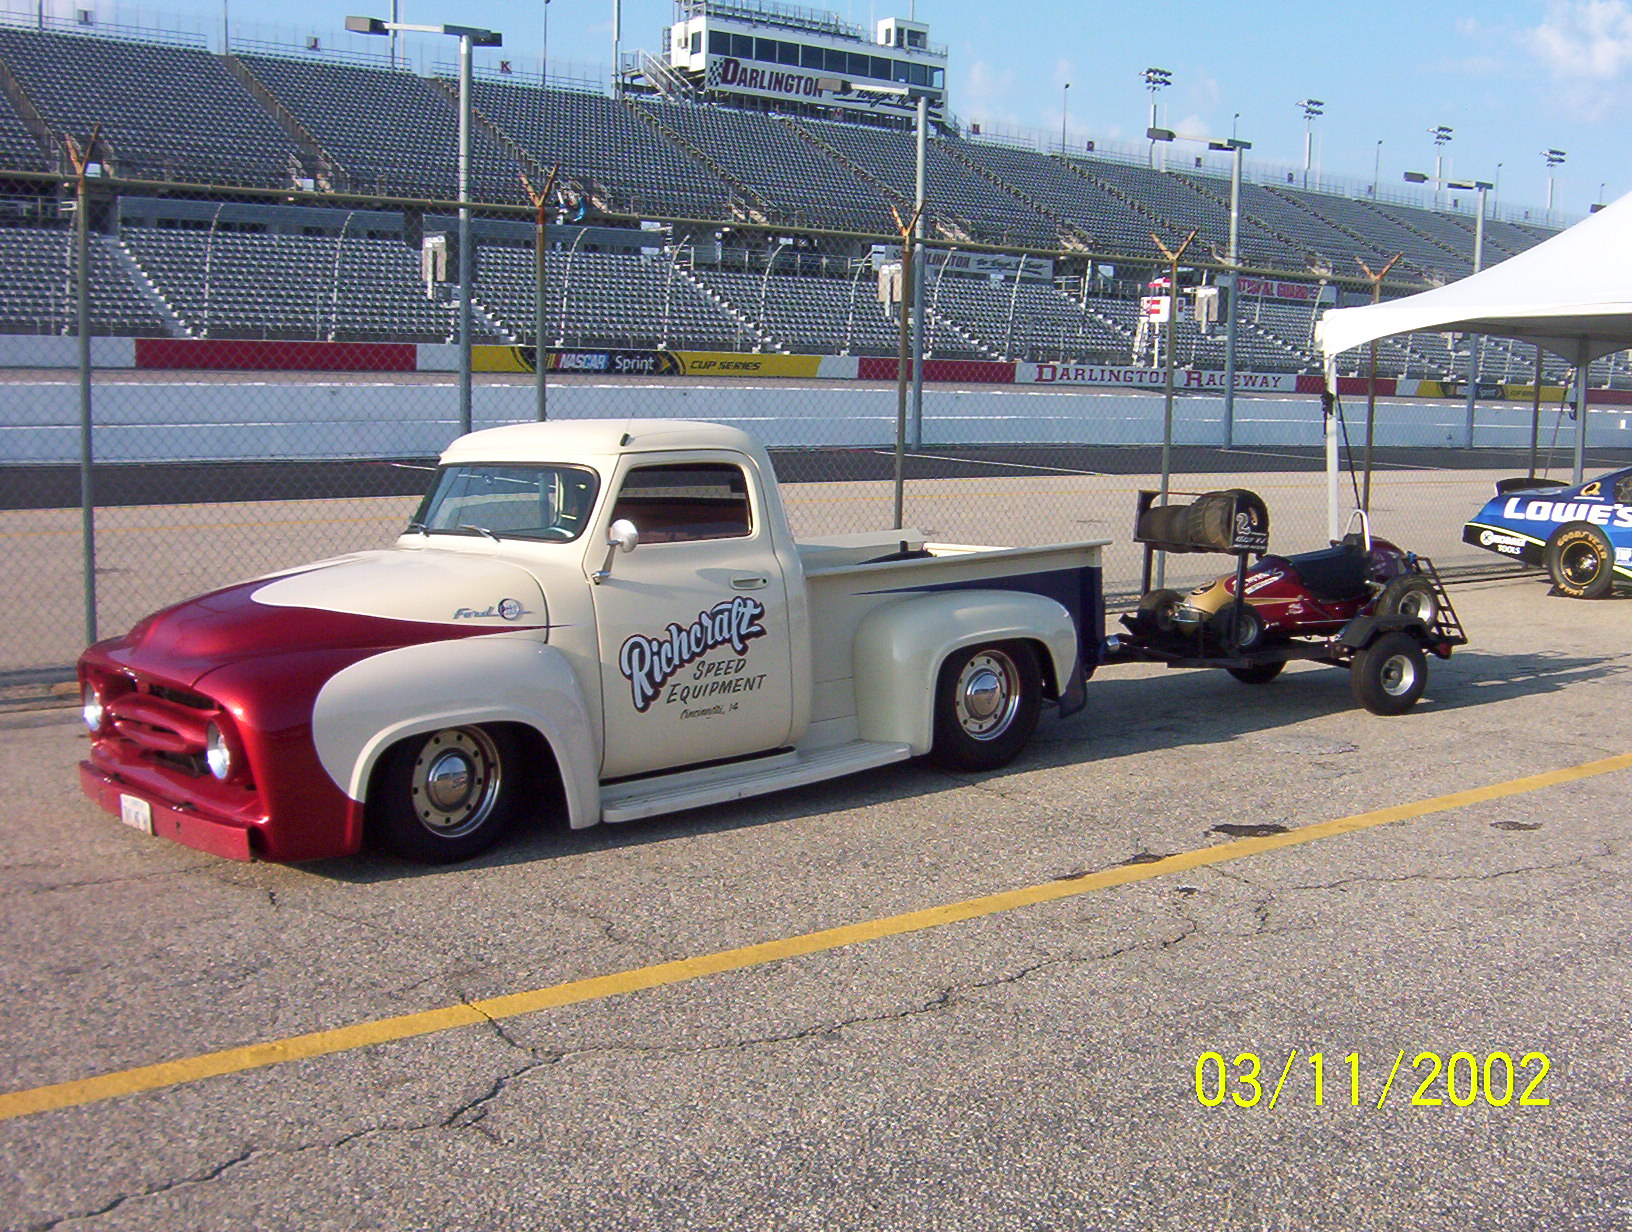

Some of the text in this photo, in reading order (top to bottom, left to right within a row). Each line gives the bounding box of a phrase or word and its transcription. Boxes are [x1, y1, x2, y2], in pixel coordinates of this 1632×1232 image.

[500, 61, 511, 74] K
[720, 58, 824, 98] DARLINGTON
[559, 353, 608, 370] NASCAR
[615, 355, 762, 374] Sprint CUP SERIES
[1235, 512, 1251, 535] 2
[619, 595, 768, 714] Richcraft
[693, 658, 747, 681] SPEED
[666, 674, 767, 704] EQUIPMENT
